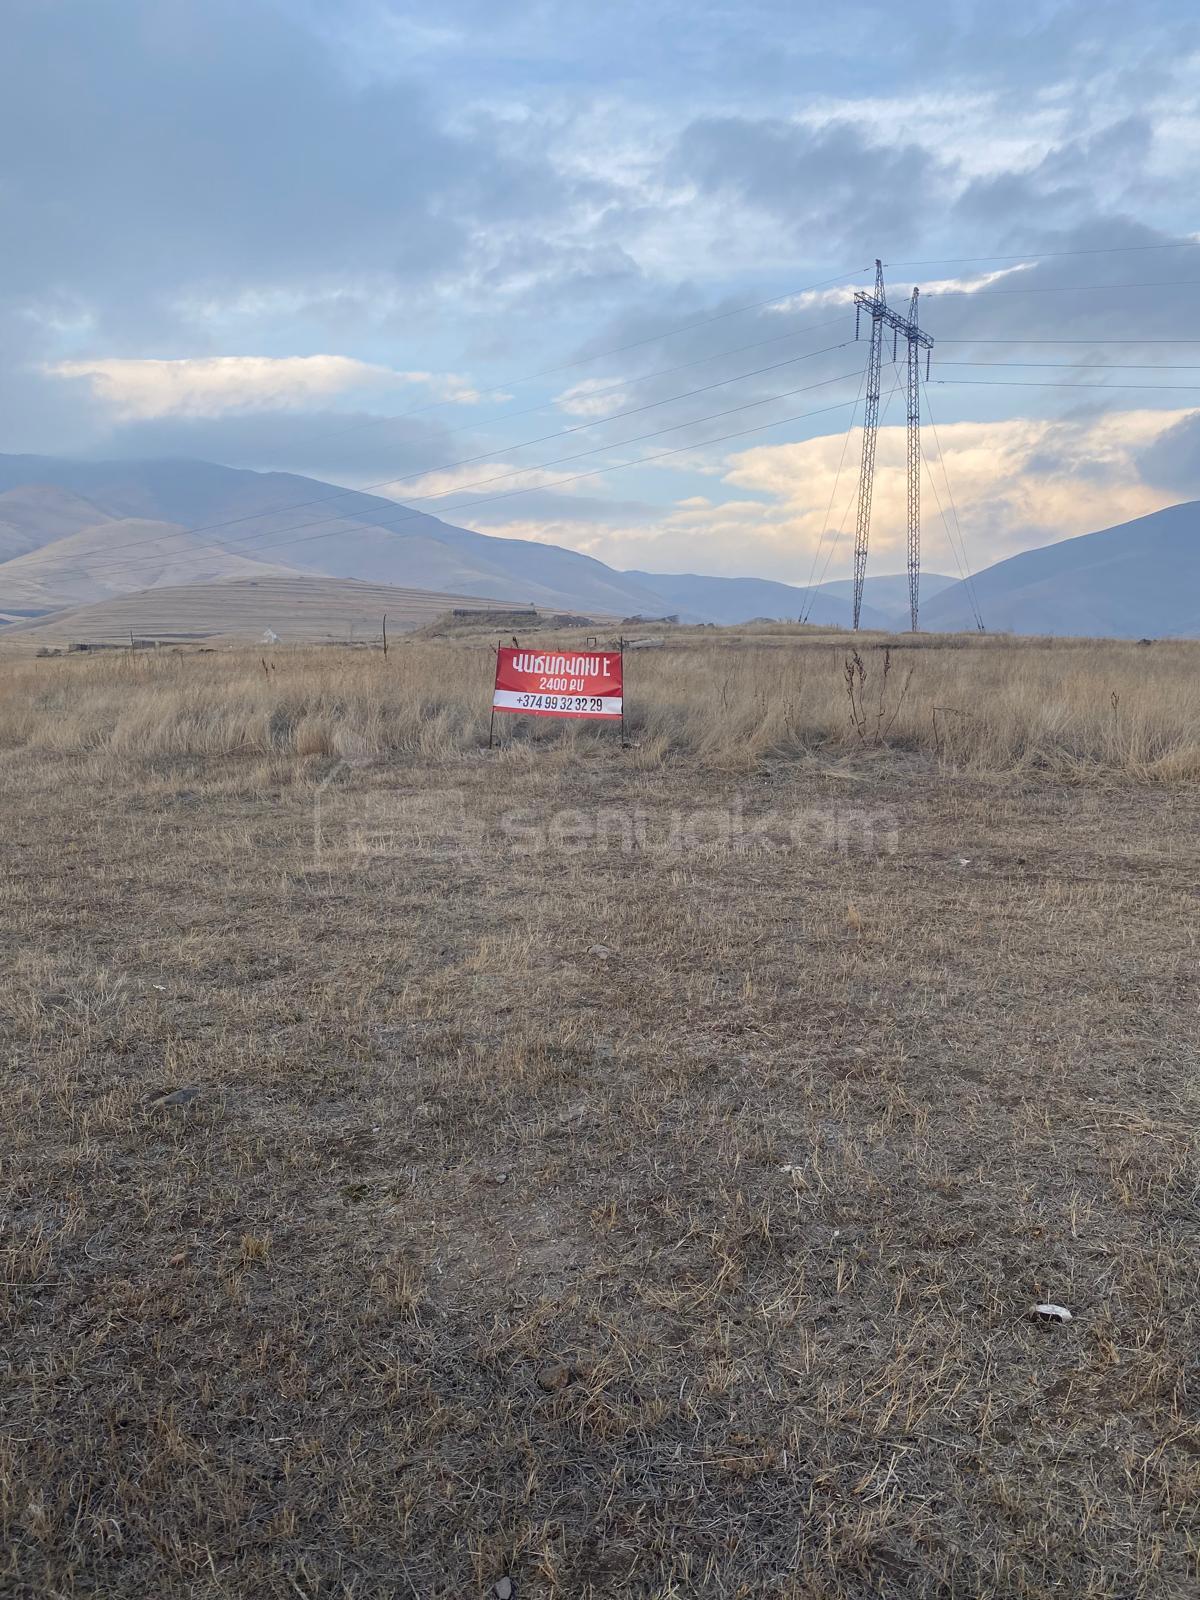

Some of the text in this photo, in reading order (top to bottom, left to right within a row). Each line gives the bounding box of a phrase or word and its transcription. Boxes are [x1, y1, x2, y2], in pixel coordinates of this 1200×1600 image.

[539, 677, 568, 691] 2400
[517, 695, 603, 712] +374 99 32 32 29
